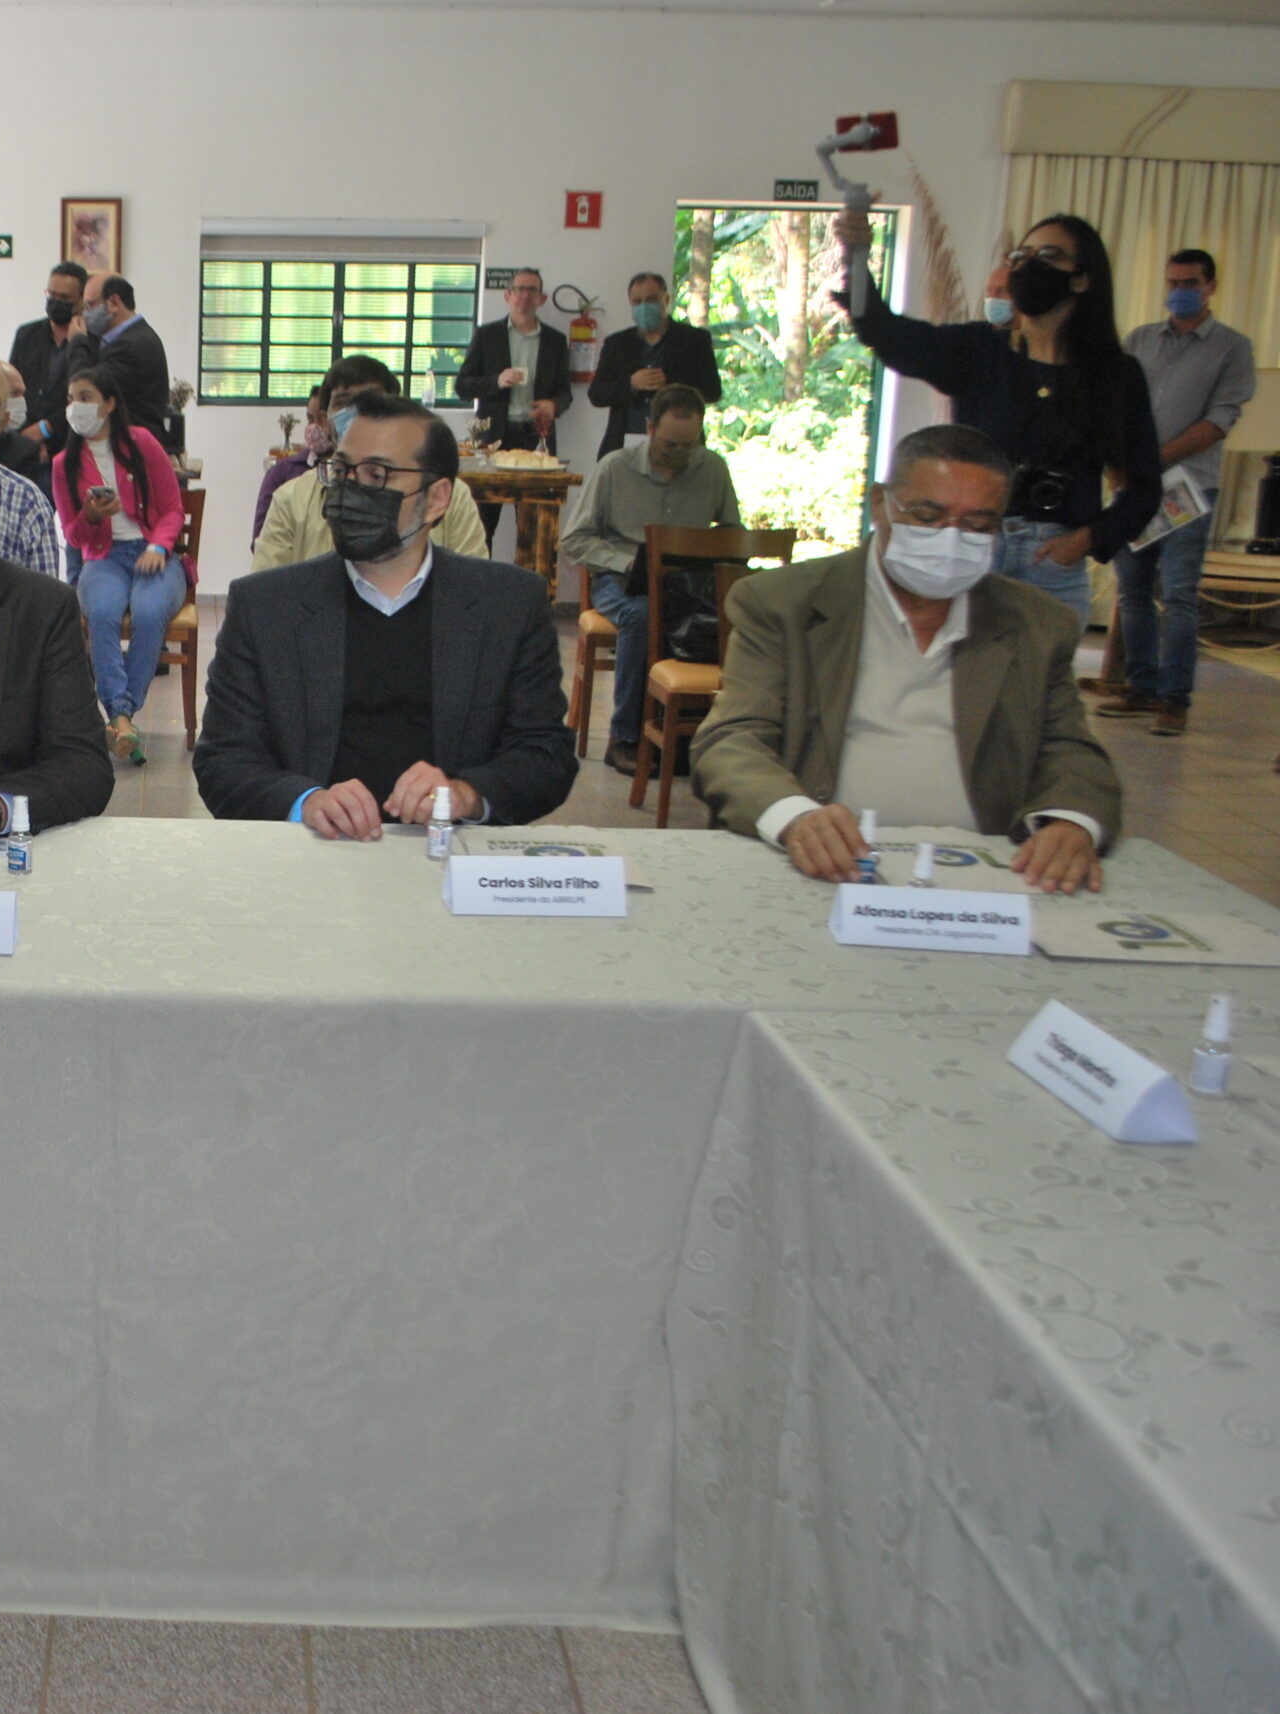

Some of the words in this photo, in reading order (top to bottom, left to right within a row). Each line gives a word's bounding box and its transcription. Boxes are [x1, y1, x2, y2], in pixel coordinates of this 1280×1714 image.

[775, 181, 816, 199] SAÍDA
[478, 876, 525, 889] Carlos
[527, 876, 562, 889] Silva
[565, 877, 600, 889] Filho
[493, 895, 537, 903] Presidente
[910, 908, 954, 924] Lopes
[957, 910, 978, 923] da
[981, 912, 1019, 926] Silva
